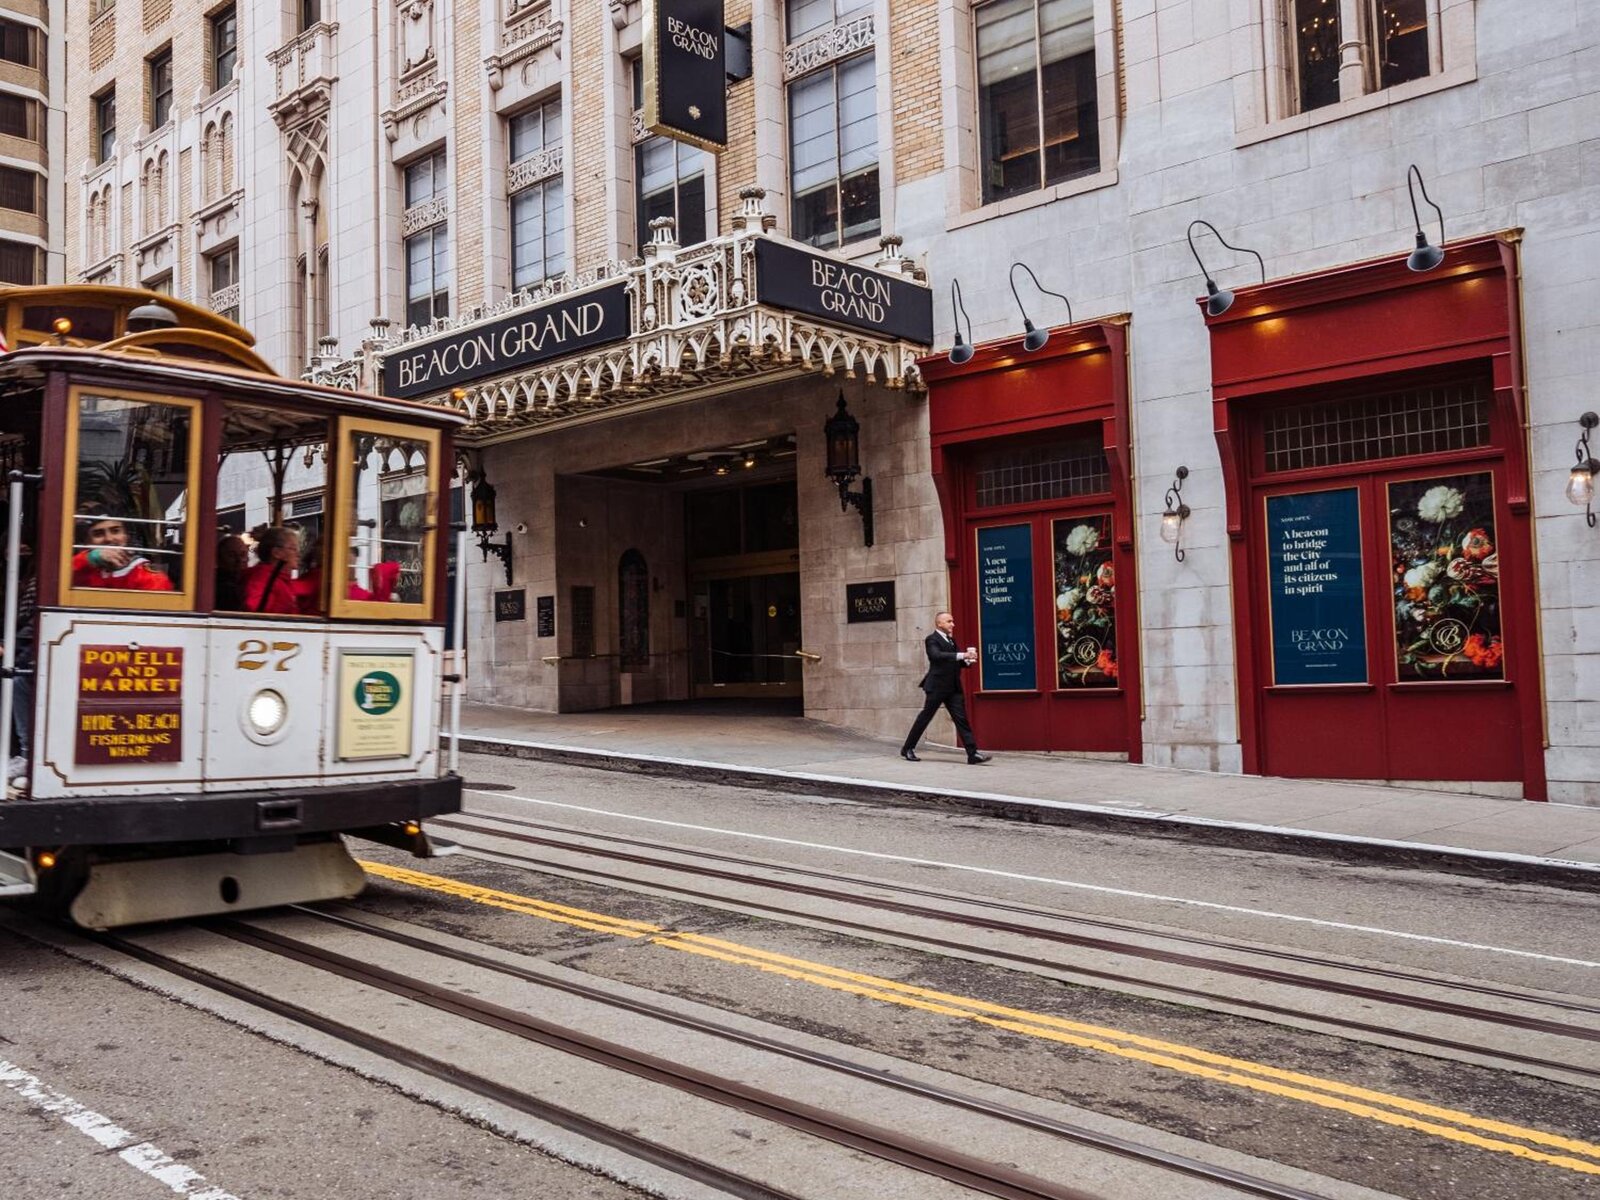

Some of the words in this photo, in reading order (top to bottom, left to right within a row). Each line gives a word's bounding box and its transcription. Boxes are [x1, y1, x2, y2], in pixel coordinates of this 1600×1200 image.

[667, 16, 718, 51] BEACON
[672, 34, 715, 60] GRAND
[811, 259, 891, 306] BEACON
[821, 289, 885, 323] GRAND
[399, 332, 496, 388] BEACON
[501, 302, 605, 358] GRAND
[1282, 530, 1291, 540] A
[1291, 528, 1329, 539] beacon
[1282, 541, 1293, 551] to
[1294, 539, 1327, 550] bridge
[991, 558, 1007, 566] new
[1283, 552, 1299, 562] the
[1300, 550, 1321, 561] City
[984, 566, 1007, 575] social
[1284, 562, 1303, 573] and
[1304, 560, 1317, 571] all
[1318, 559, 1331, 570] of
[984, 576, 1005, 585] circle
[1006, 575, 1015, 583] at
[1284, 574, 1297, 584] its
[1297, 572, 1338, 583] citizens
[985, 585, 1008, 594] Union
[1284, 585, 1295, 595] in
[1296, 583, 1323, 596] spirit
[984, 595, 1013, 605] Square
[1291, 628, 1349, 643] BEACON
[987, 642, 1030, 654] BEACON
[1297, 640, 1344, 652] GRAND
[84, 650, 180, 666] POWELL
[236, 639, 302, 672] 27
[992, 652, 1026, 662] GRAND
[109, 666, 159, 677] AND
[81, 678, 180, 692] MARKET
[81, 714, 118, 731] HYDE
[135, 713, 180, 730] BEACH
[89, 733, 172, 746] FISHERMANS
[108, 745, 153, 757] WHARF
